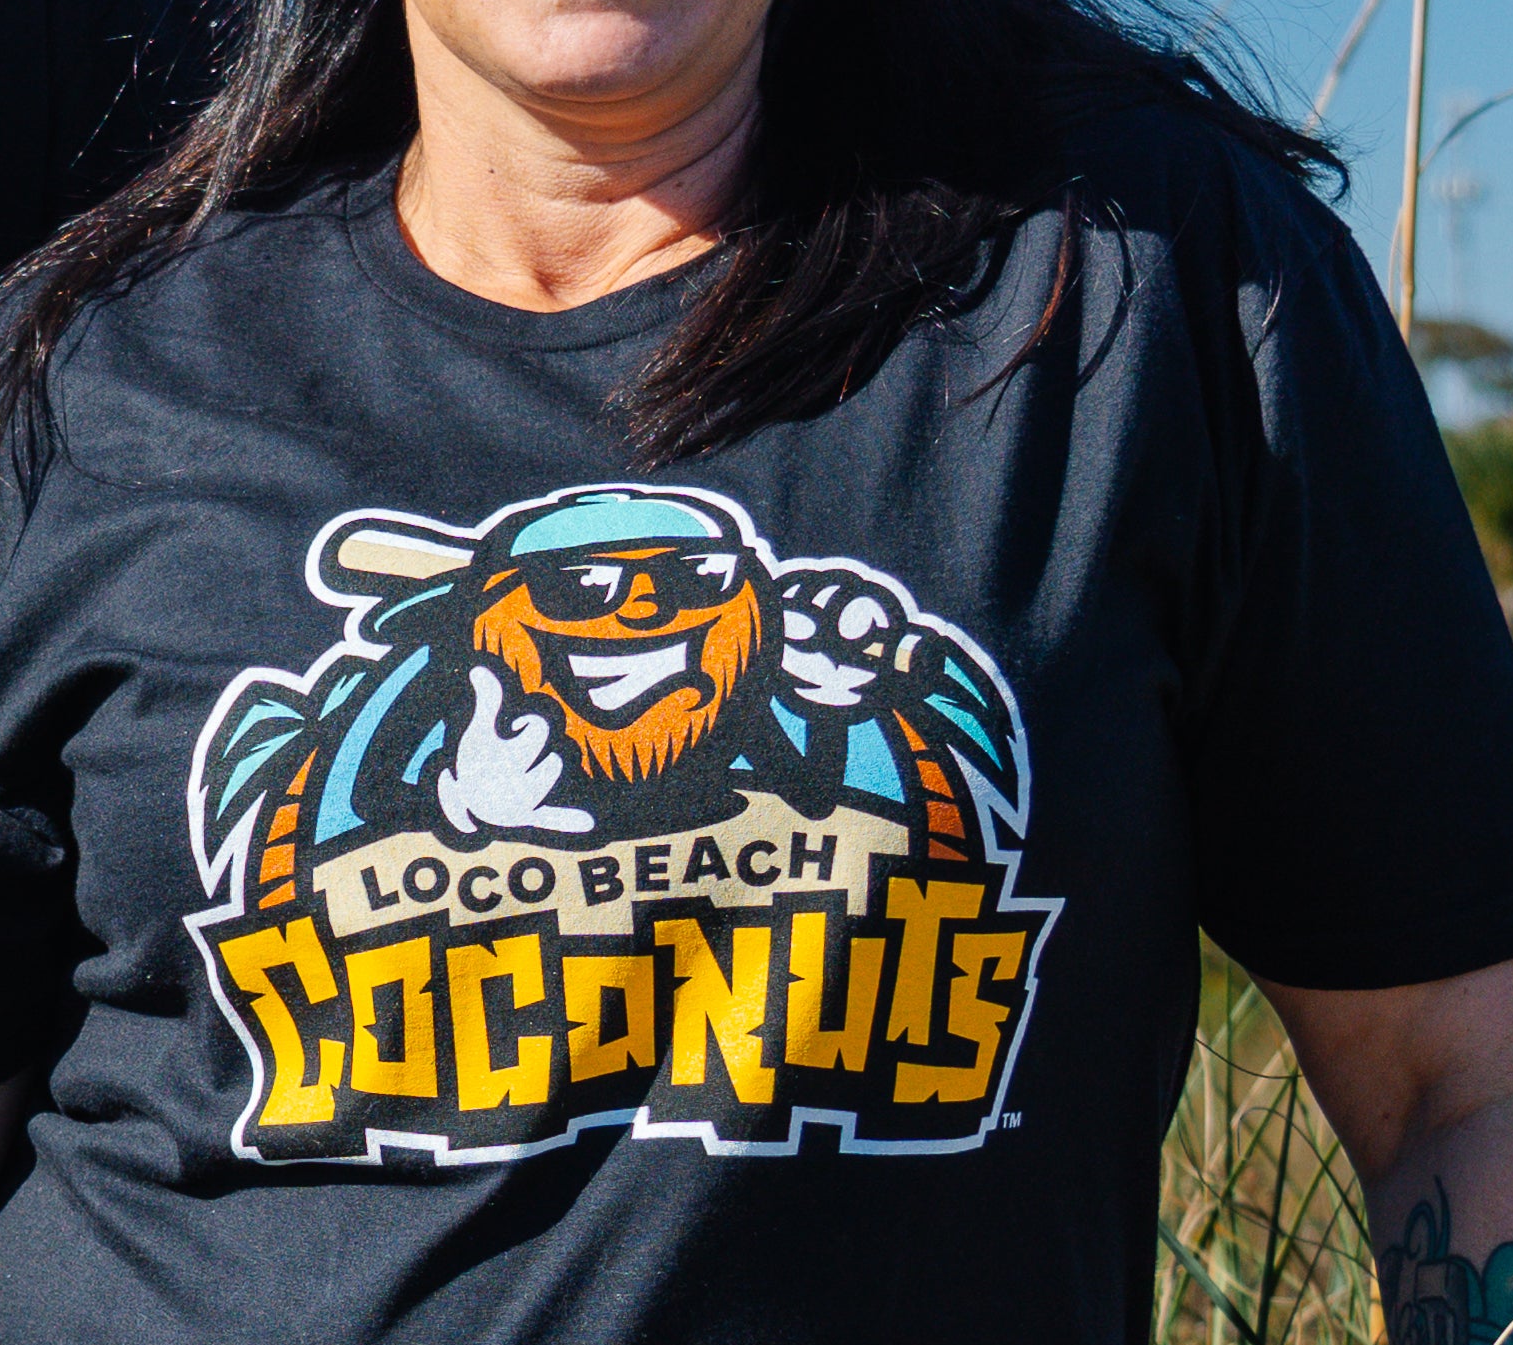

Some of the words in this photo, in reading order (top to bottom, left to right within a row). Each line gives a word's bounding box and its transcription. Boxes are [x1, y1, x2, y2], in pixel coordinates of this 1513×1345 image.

[359, 855, 557, 913] LOCO
[577, 831, 838, 906] BEACH
[218, 876, 1027, 1127] COCONUTS
[1002, 1111, 1022, 1129] TM
